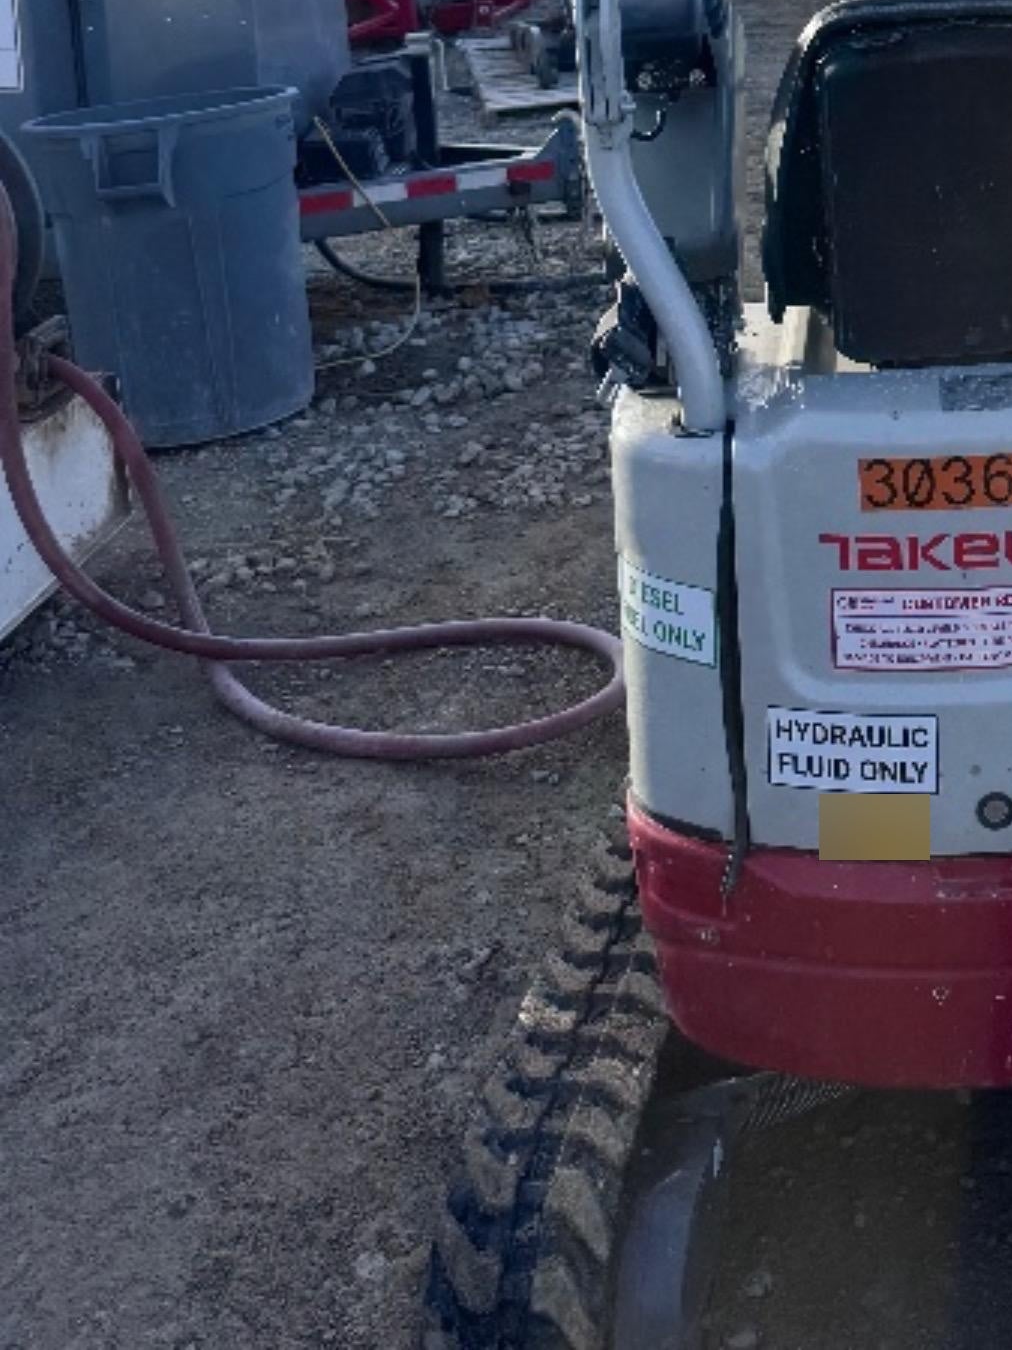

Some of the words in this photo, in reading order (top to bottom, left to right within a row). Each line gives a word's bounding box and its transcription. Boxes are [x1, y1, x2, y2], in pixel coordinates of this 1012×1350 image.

[653, 620, 706, 652] ONLY
[776, 718, 929, 748] HYDRAULIC
[778, 753, 850, 780] FLUID
[860, 759, 928, 784] ONLY
